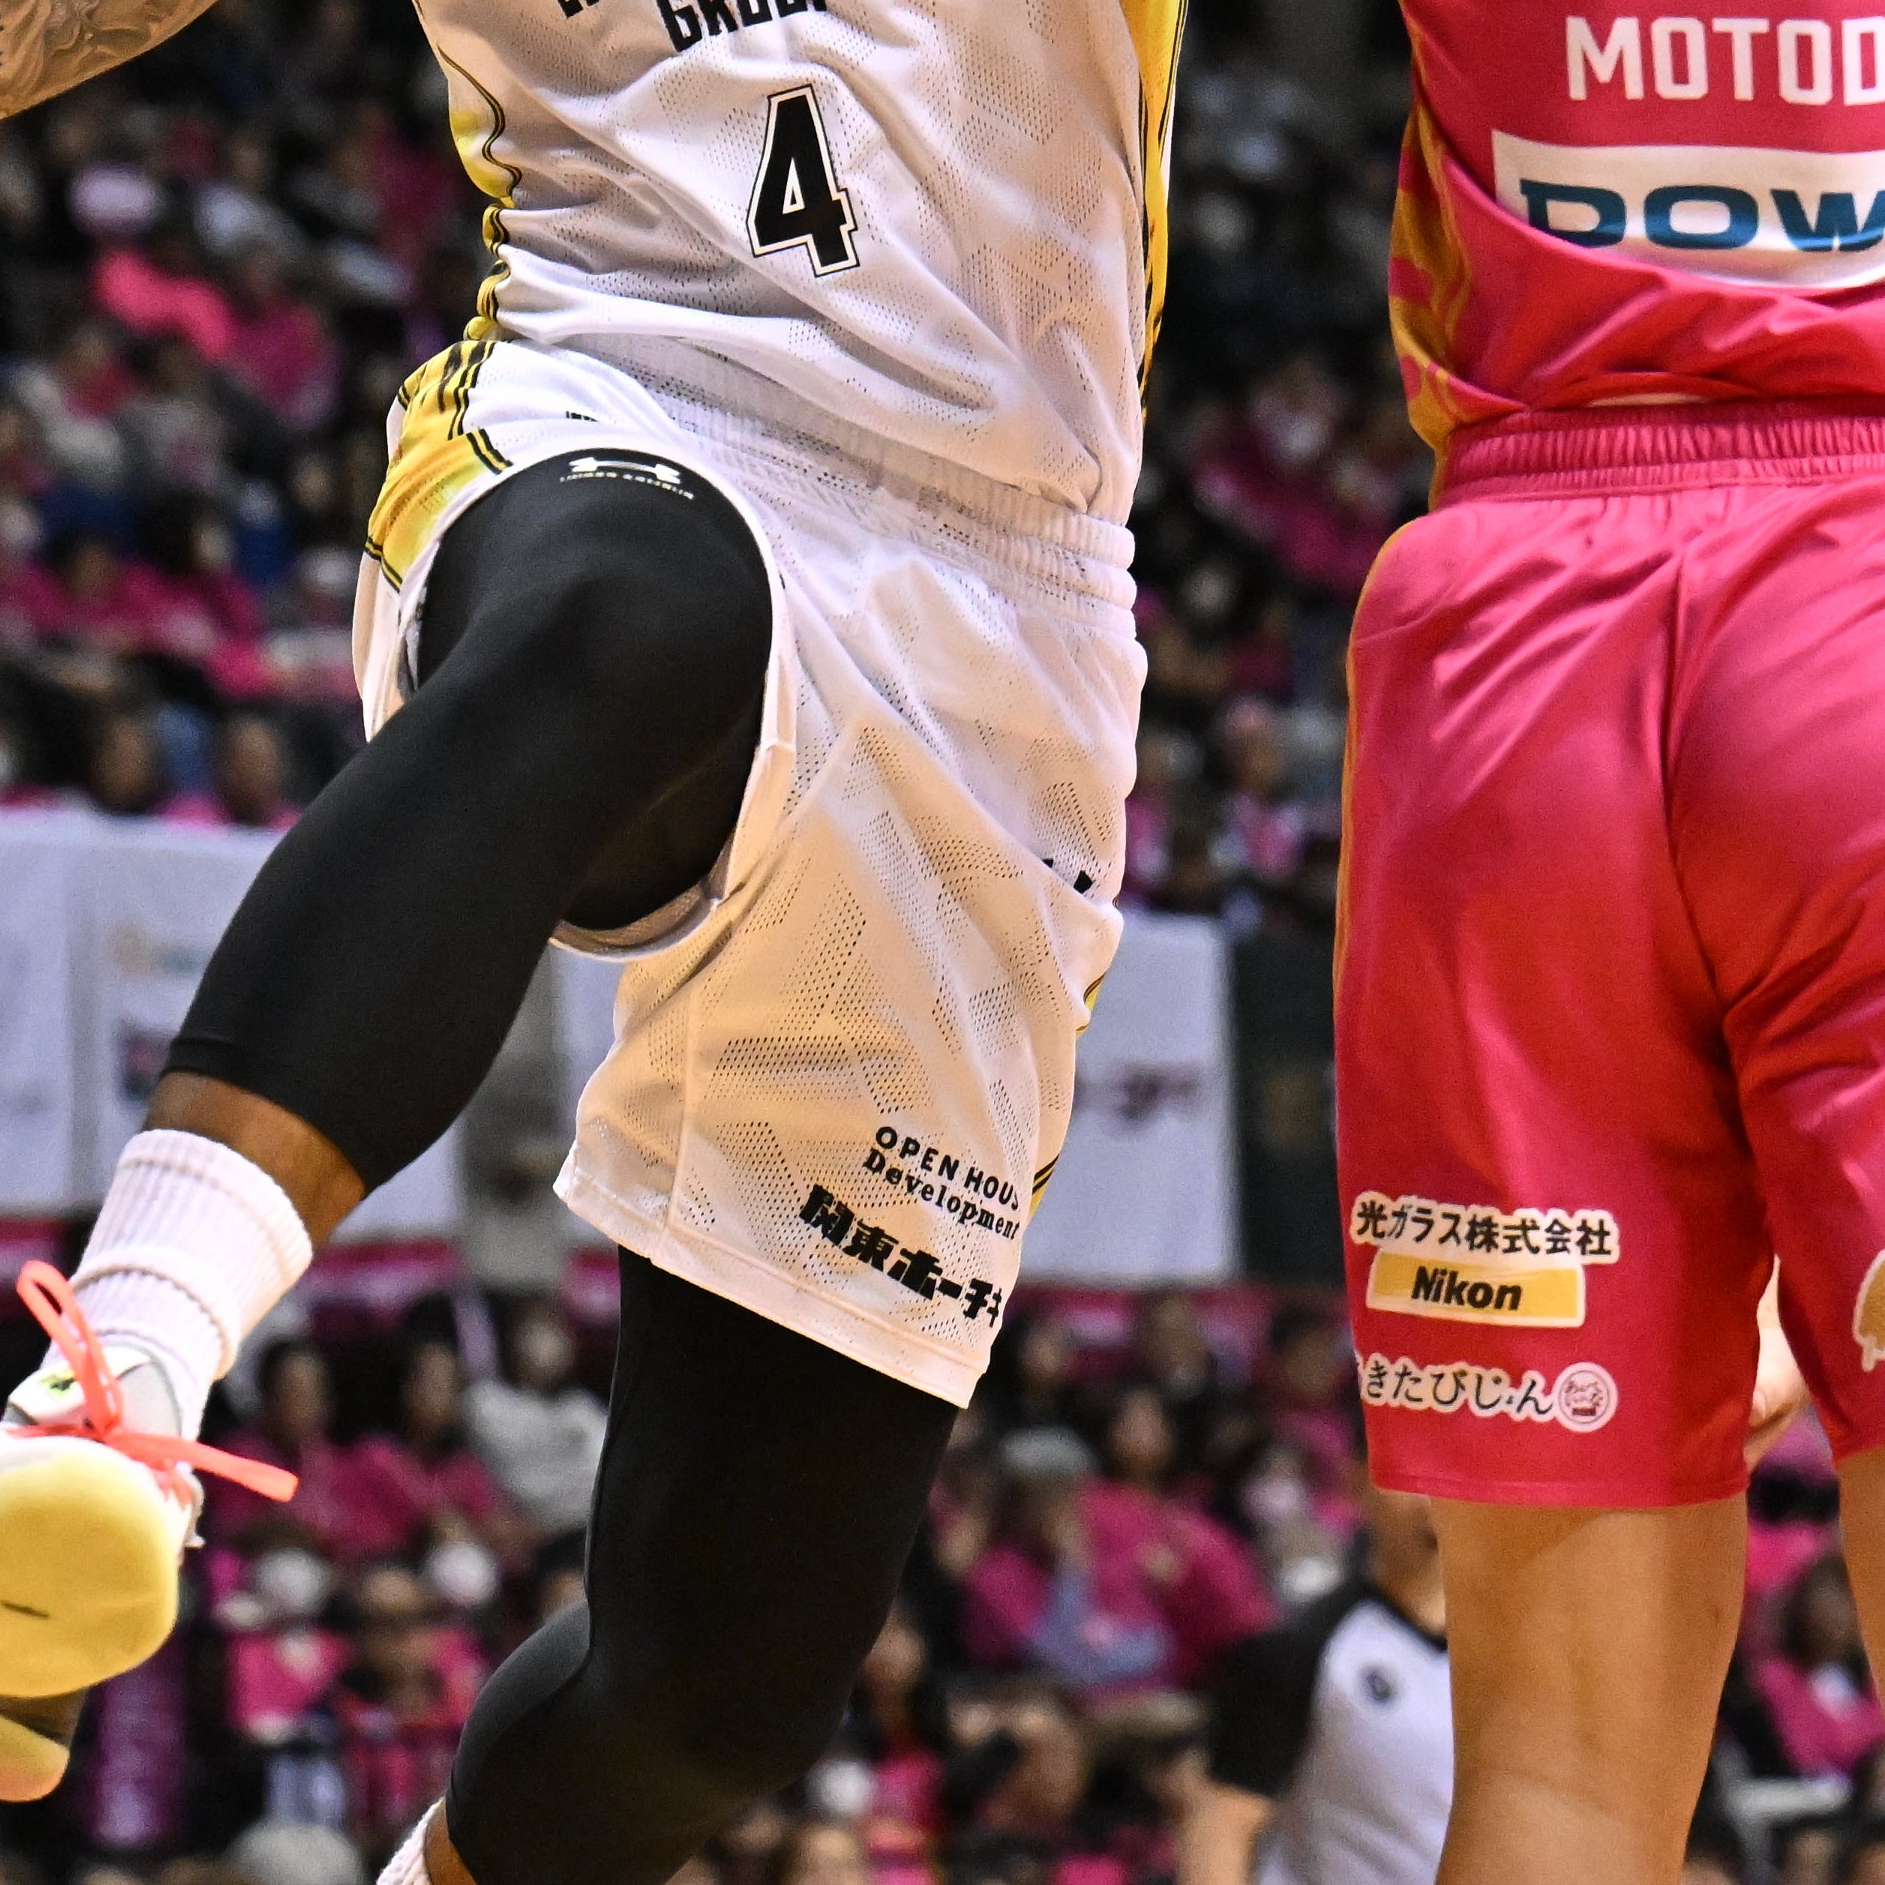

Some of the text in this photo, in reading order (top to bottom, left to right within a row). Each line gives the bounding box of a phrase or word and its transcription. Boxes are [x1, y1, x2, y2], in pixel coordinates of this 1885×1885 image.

[746, 83, 860, 278] 4
[862, 1148, 1021, 1241] Development
[874, 1126, 1020, 1212] OPEN HOU
[1356, 1200, 1612, 1257] 光ガラス株式会社
[1410, 1266, 1523, 1311] Nikon
